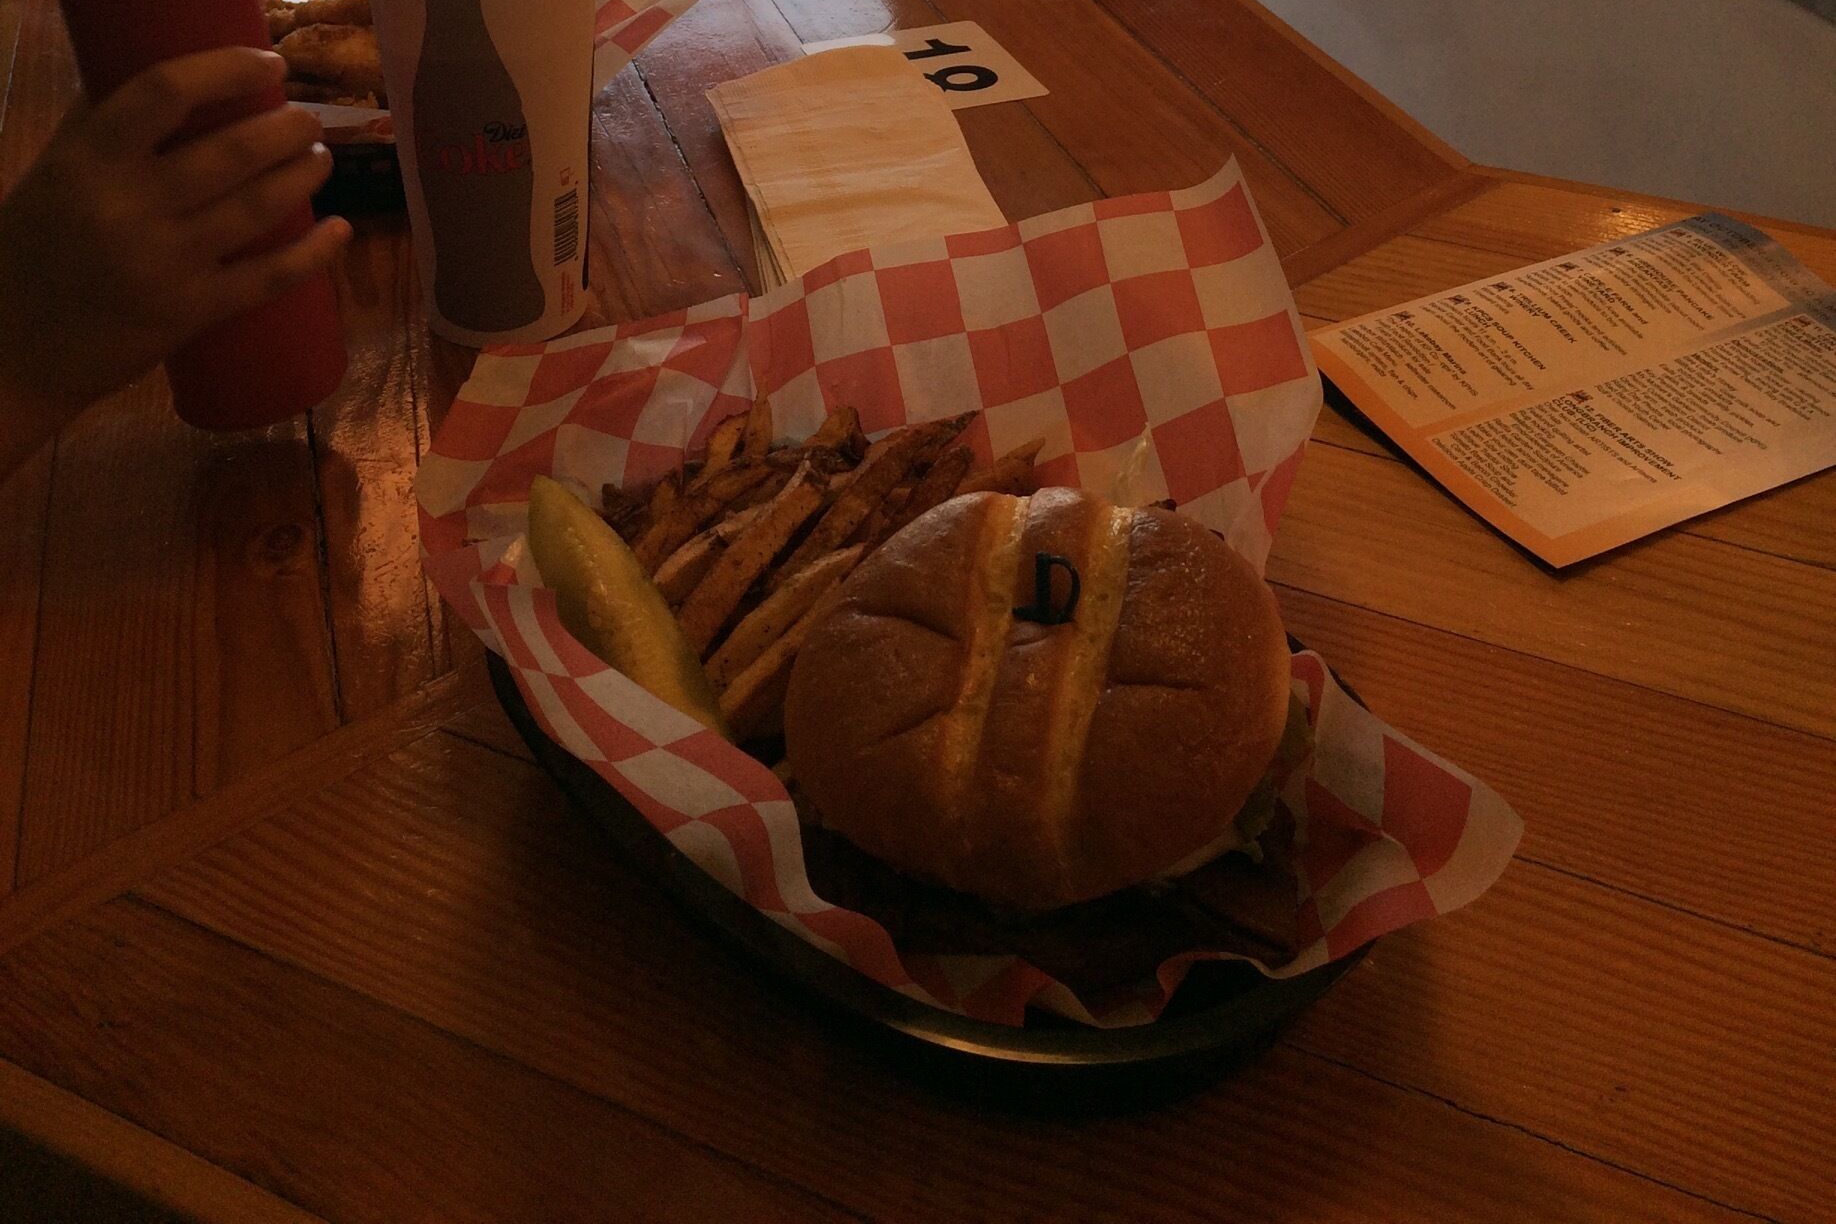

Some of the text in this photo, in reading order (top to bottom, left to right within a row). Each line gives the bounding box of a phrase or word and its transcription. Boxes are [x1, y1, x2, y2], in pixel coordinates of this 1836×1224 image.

[416, 129, 531, 177] oke
[1463, 307, 1491, 328] LUNCH
[1508, 294, 1540, 317] WINERY
[1490, 321, 1515, 340] SOUP
[1511, 340, 1547, 370] KITCHEN
[1548, 319, 1577, 343] CREEK
[1441, 352, 1468, 375] Marina
[1558, 396, 1682, 480] LONGBRANCH IMPROVEMENT
[1594, 413, 1623, 432] FIBER
[1619, 431, 1647, 449] ARTS
[1644, 449, 1674, 467] SHOW
[1012, 551, 1081, 624] D
